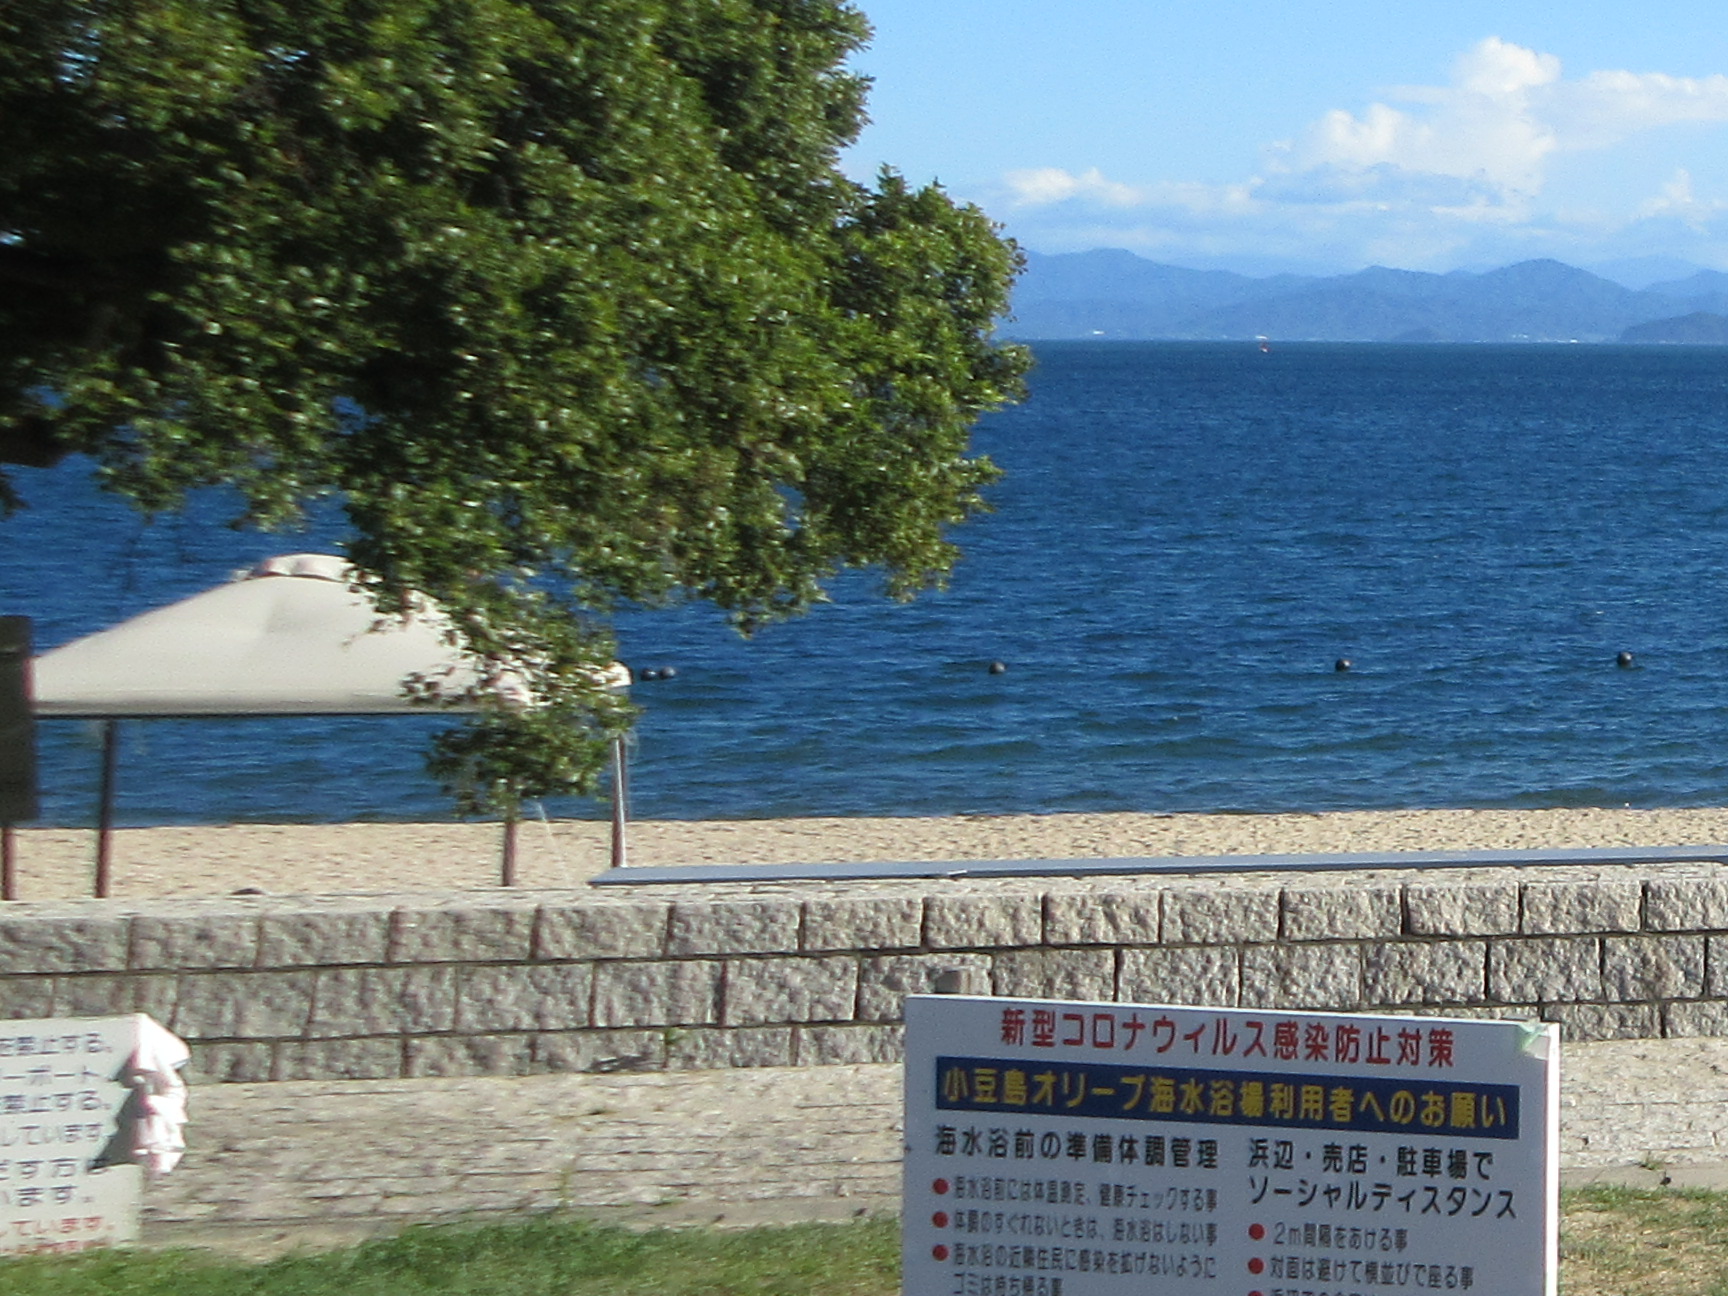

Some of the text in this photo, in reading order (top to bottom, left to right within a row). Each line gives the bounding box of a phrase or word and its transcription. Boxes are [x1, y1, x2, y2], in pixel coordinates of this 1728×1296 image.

[1000, 1007, 1455, 1069] 新型コロナウィルス感染防止対策
[943, 1065, 1507, 1130] 小豆島オリーブ海水浴場利用者へのお願い
[934, 1124, 1219, 1169] 海水浴前の準備体調管理
[1248, 1138, 1494, 1180] 浜辺・売店・駐車場で
[1248, 1176, 1517, 1219] ソーシャルディスタンス
